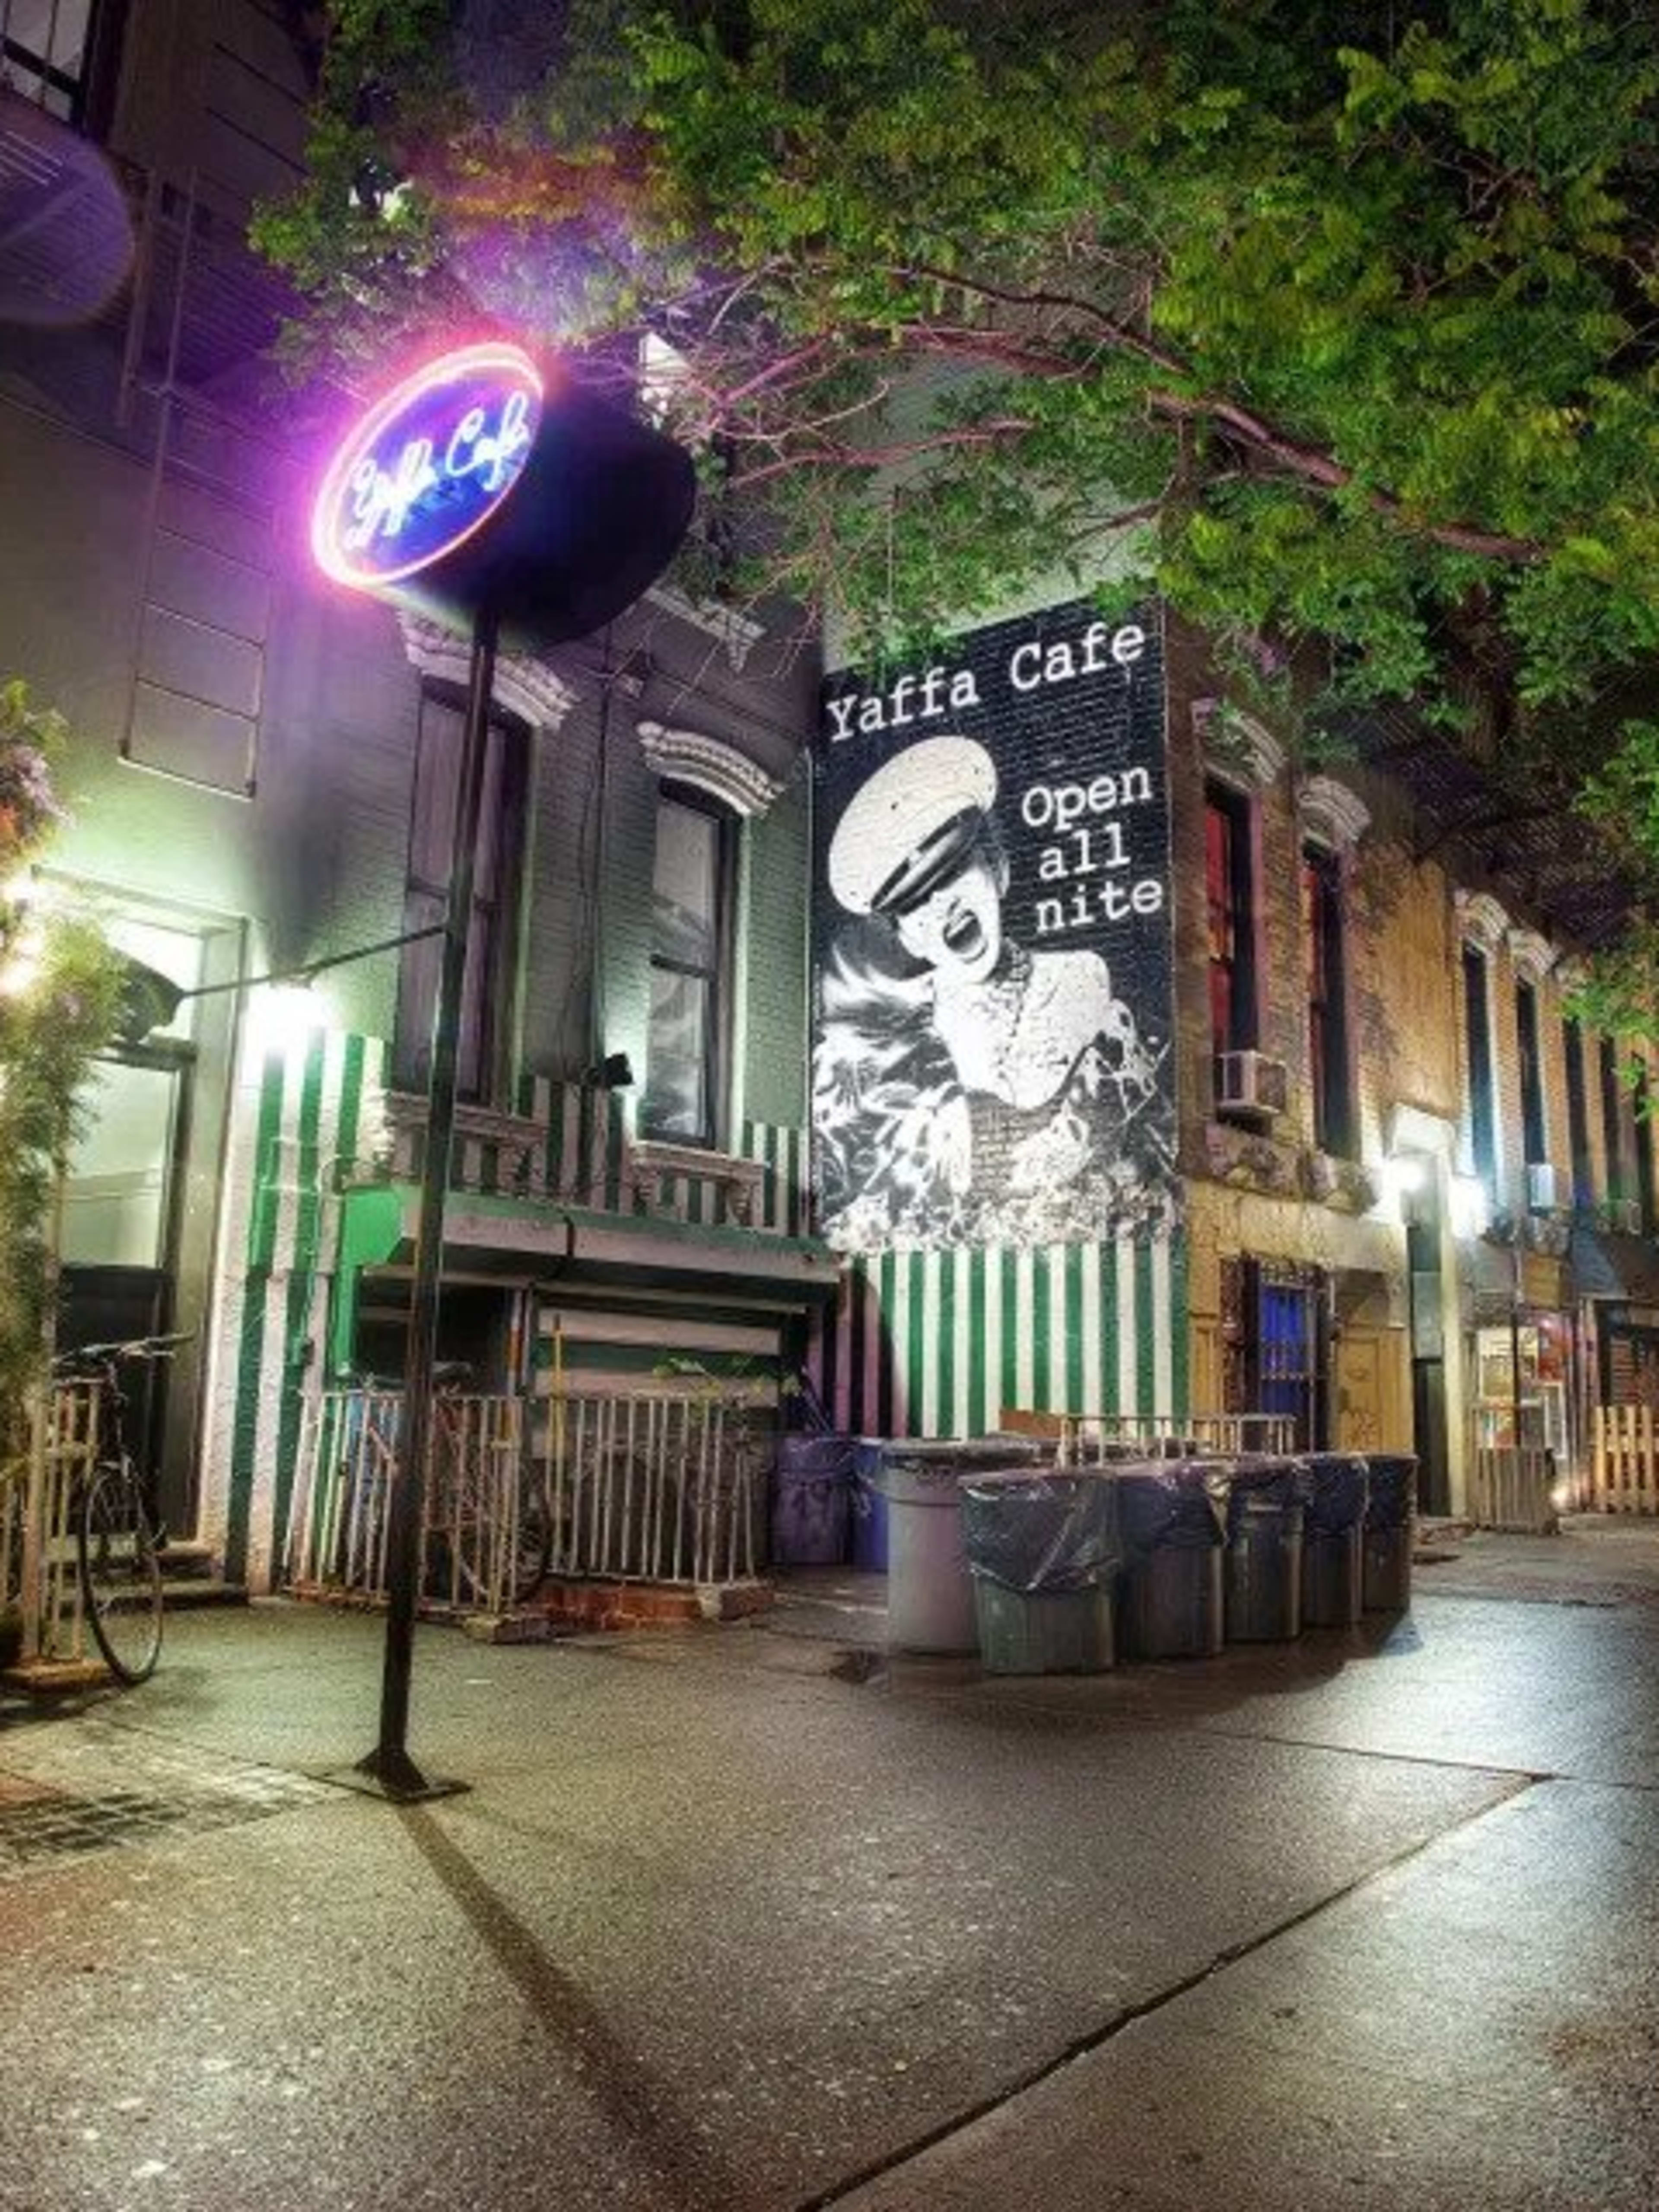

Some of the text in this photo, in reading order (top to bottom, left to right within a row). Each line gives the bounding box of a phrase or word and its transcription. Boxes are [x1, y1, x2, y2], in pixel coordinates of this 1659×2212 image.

[445, 390, 531, 491] Cafe
[826, 622, 1146, 743] Yaffa Cafe
[1021, 765, 1153, 833] Open
[1039, 822, 1131, 882] all
[1036, 878, 1163, 933] nite
